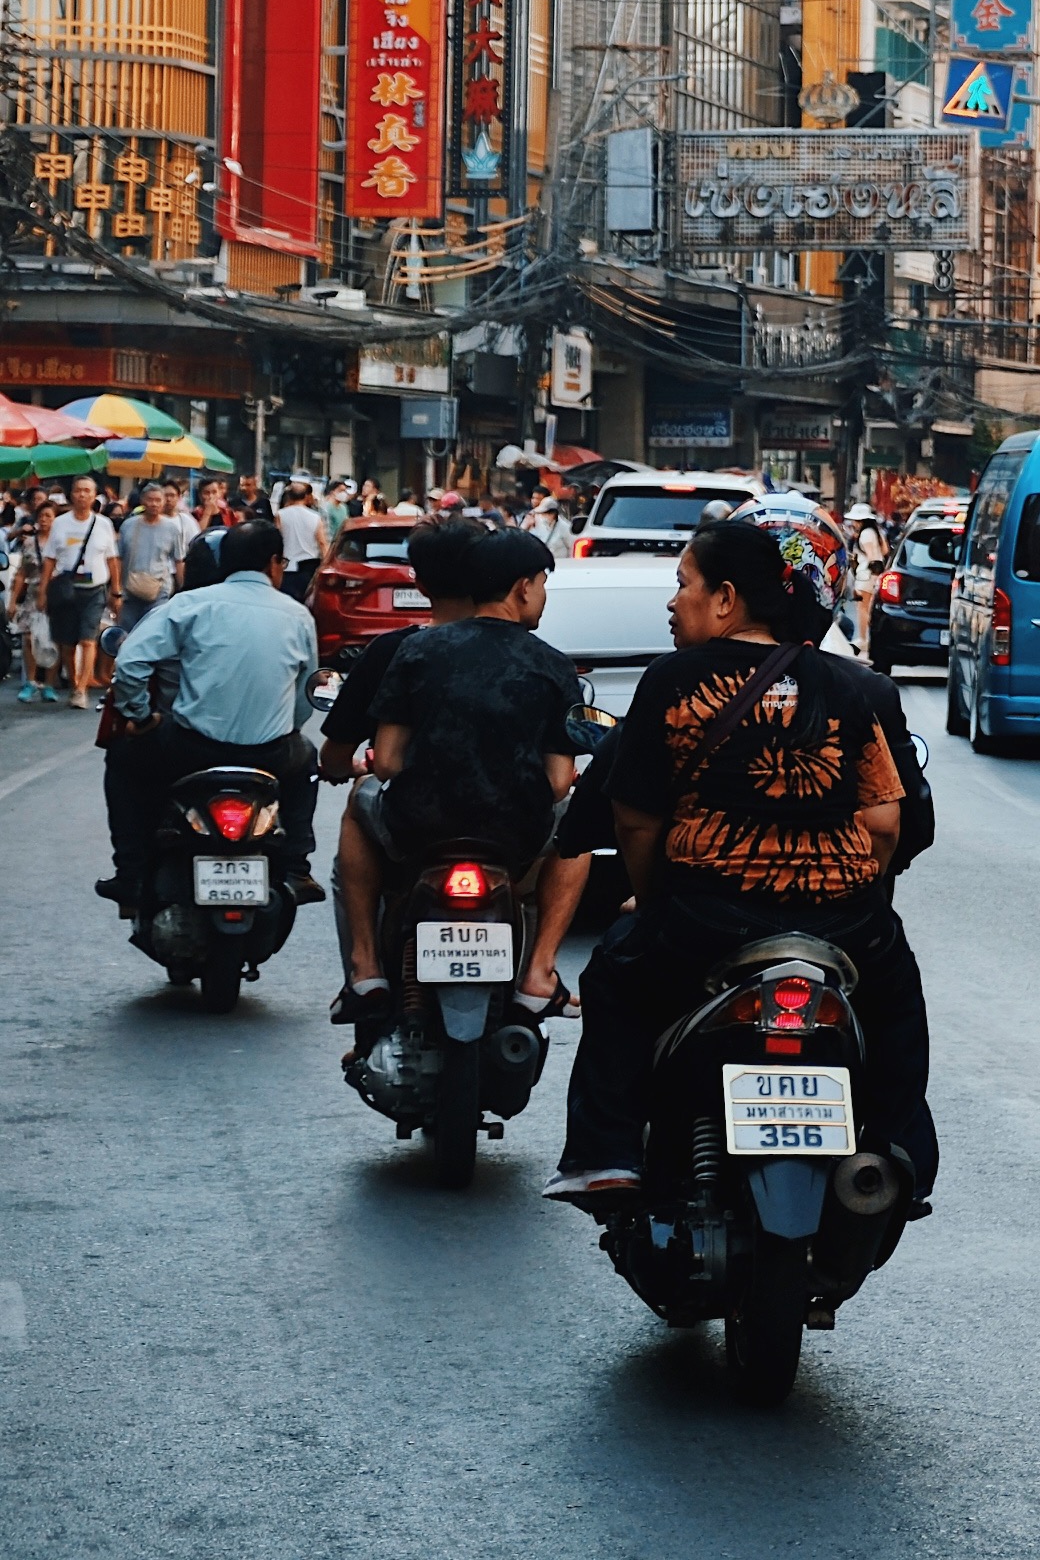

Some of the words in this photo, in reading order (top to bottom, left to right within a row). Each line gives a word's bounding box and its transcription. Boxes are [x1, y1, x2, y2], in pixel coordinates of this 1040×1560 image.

[449, 961, 482, 978] 85
[745, 1106, 833, 1119] มหาสารคาม
[759, 1124, 823, 1148] 356
